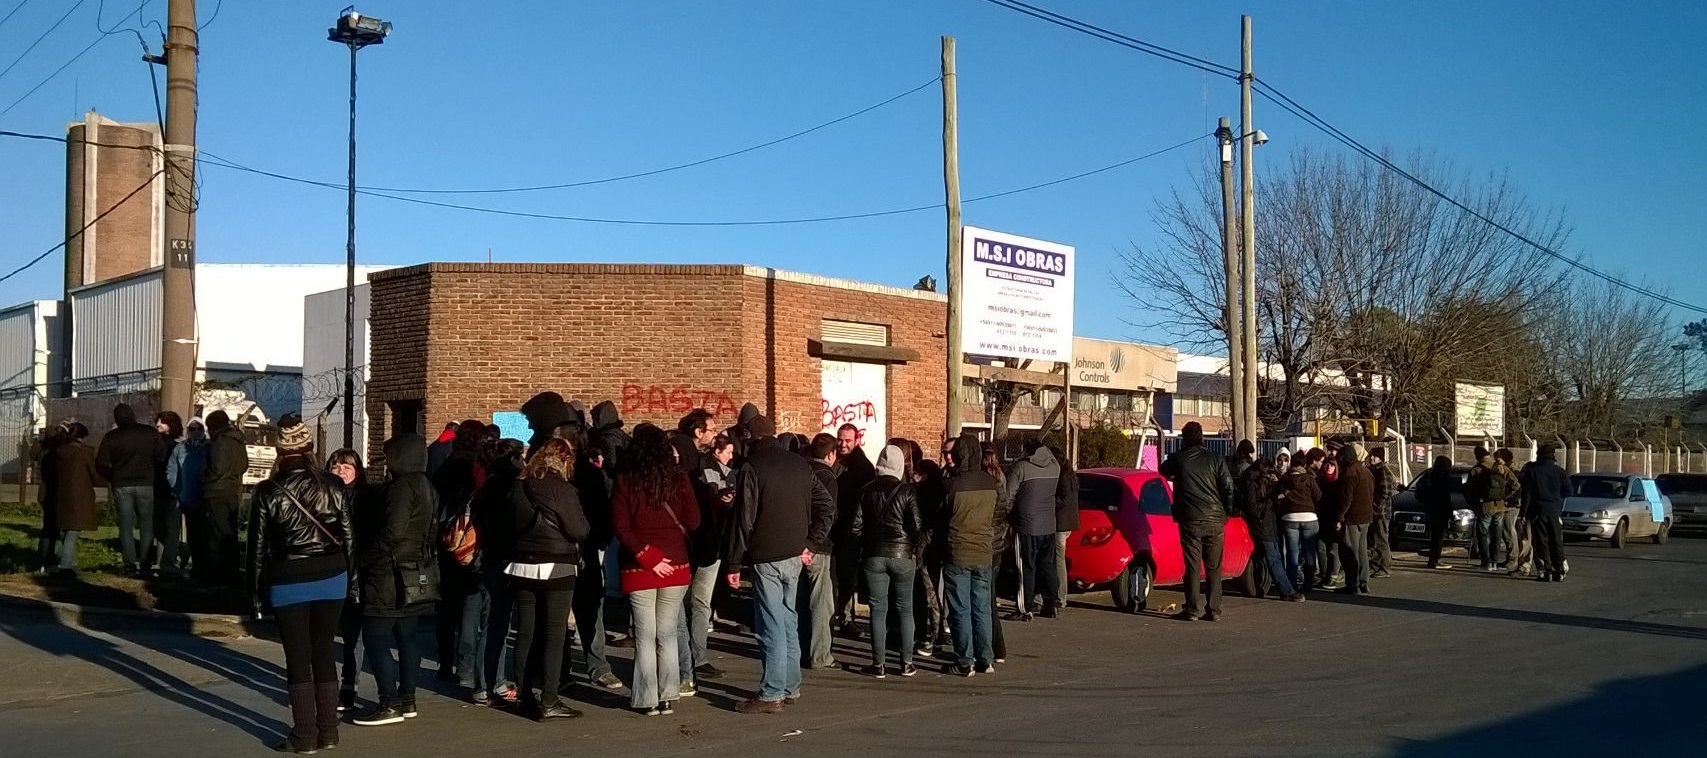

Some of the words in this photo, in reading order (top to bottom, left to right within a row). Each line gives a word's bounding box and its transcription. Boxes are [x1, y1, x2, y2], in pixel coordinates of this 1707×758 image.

[177, 253, 188, 262] 11
[976, 241, 1012, 263] M.S.I
[1015, 249, 1064, 273] OBRAS
[988, 269, 1013, 280] EMPRESA
[1013, 273, 1053, 286] CONSTRUCTORA
[1074, 357, 1105, 370] Johnson
[1079, 371, 1110, 383] Controls
[621, 383, 739, 419] BASTA
[820, 398, 877, 430] BASTA
